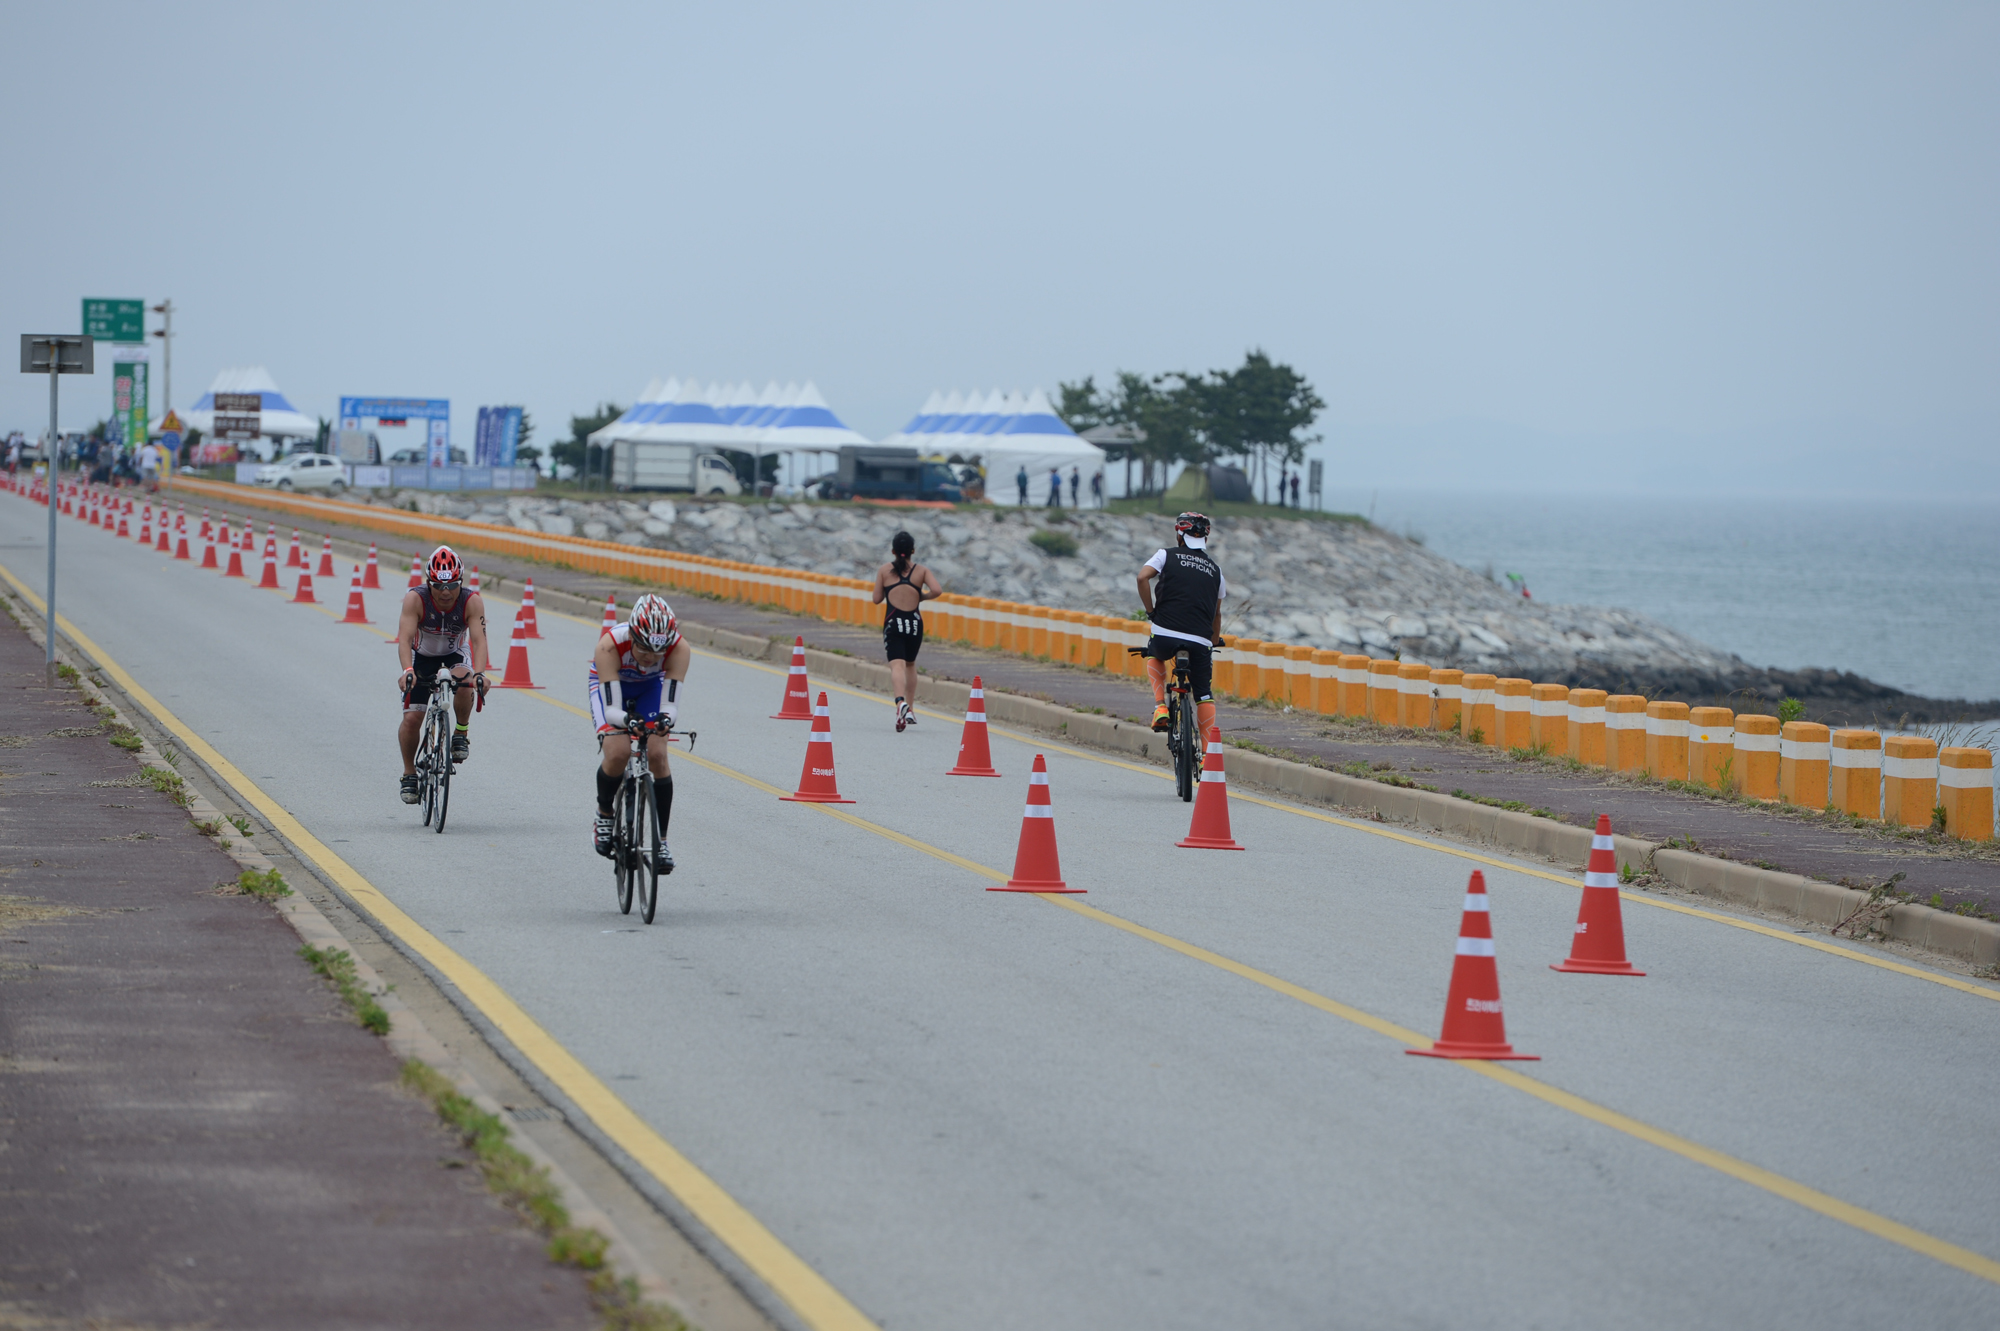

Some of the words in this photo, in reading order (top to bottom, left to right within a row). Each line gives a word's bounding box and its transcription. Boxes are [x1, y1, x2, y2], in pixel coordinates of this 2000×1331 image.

[1176, 553, 1216, 572] TECHNICAL
[1180, 560, 1213, 577] OFFICIAL
[651, 636, 666, 645] 126
